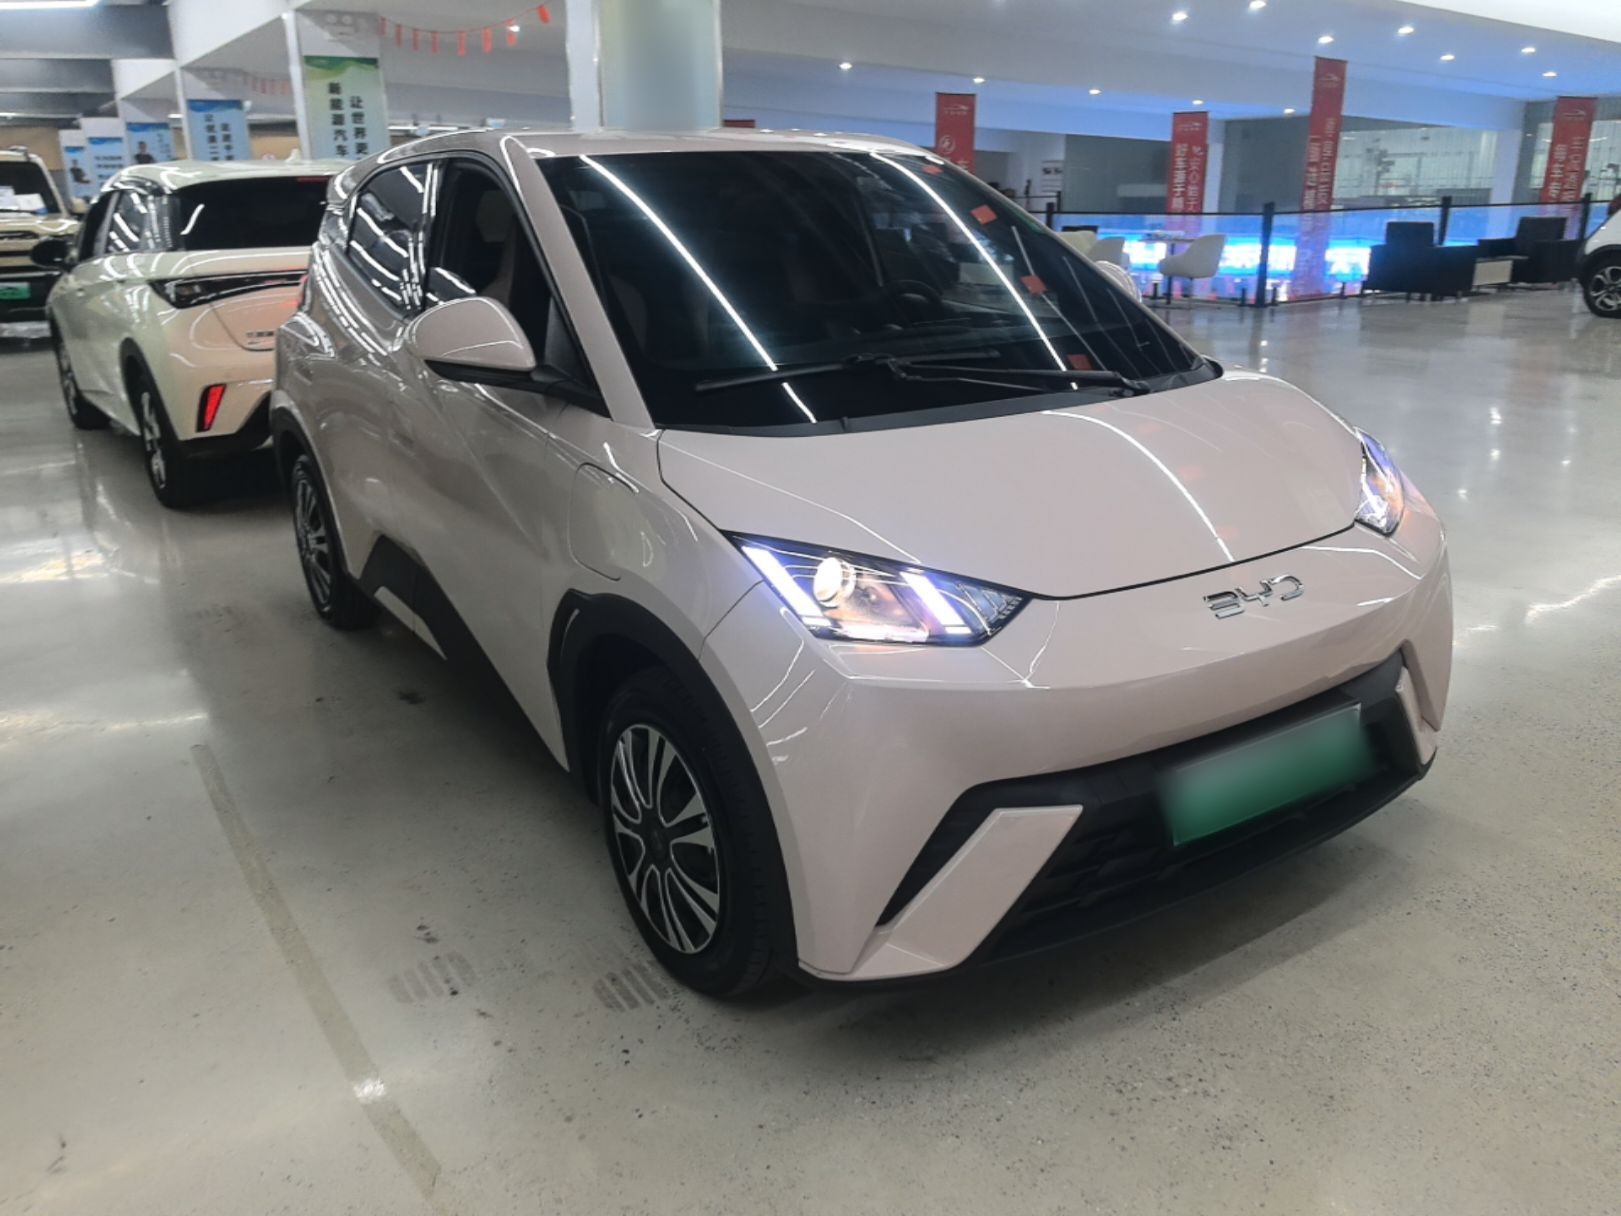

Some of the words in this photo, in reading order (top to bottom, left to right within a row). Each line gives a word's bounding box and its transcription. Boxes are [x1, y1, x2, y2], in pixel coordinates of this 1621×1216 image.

[350, 96, 368, 160] 让世界更
[1203, 574, 1304, 619] BYD
